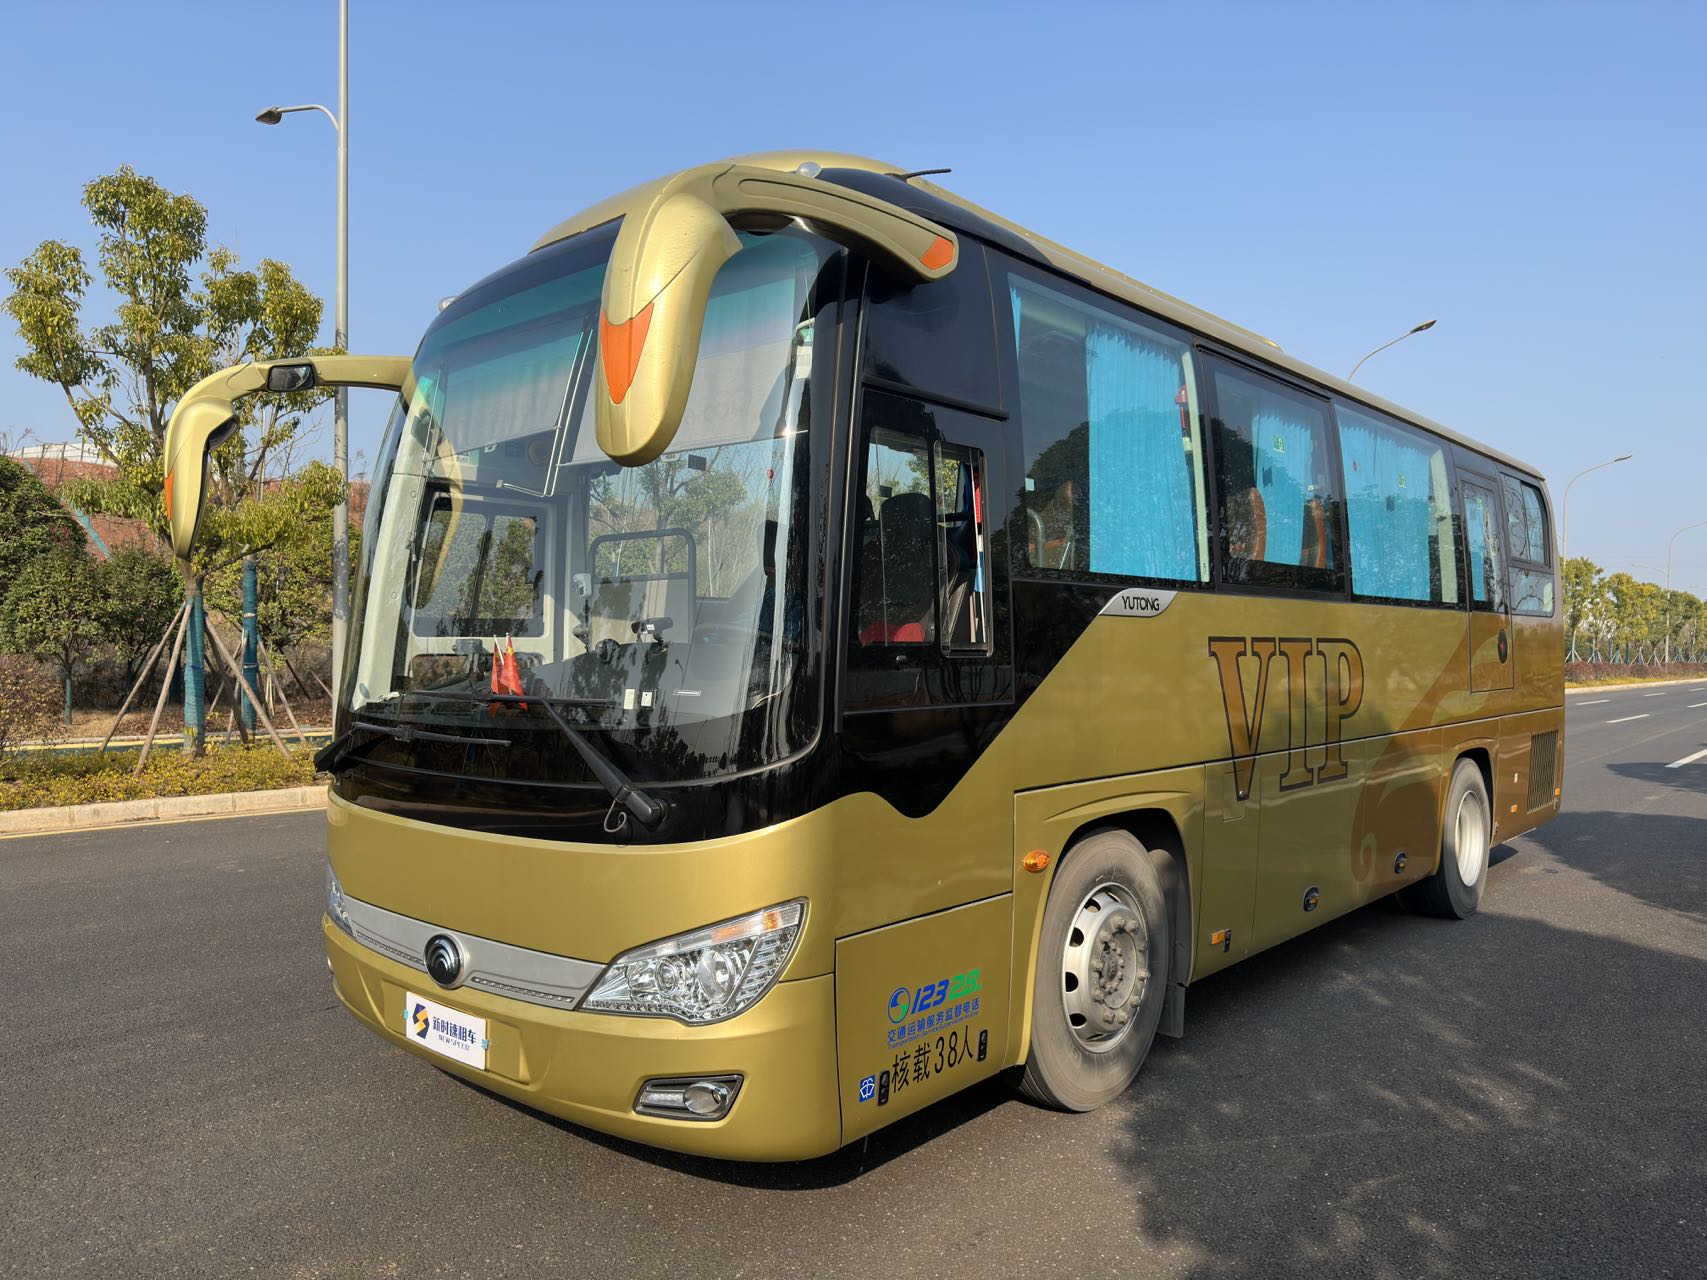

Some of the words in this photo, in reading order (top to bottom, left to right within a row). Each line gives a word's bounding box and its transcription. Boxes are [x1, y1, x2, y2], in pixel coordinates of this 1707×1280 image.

[1121, 595, 1160, 611] YUTONG
[1207, 636, 1364, 801] VIP
[911, 968, 982, 1015] 12328
[887, 997, 980, 1043] 交通运输服务监督电话
[891, 1025, 973, 1093] 核载38人
